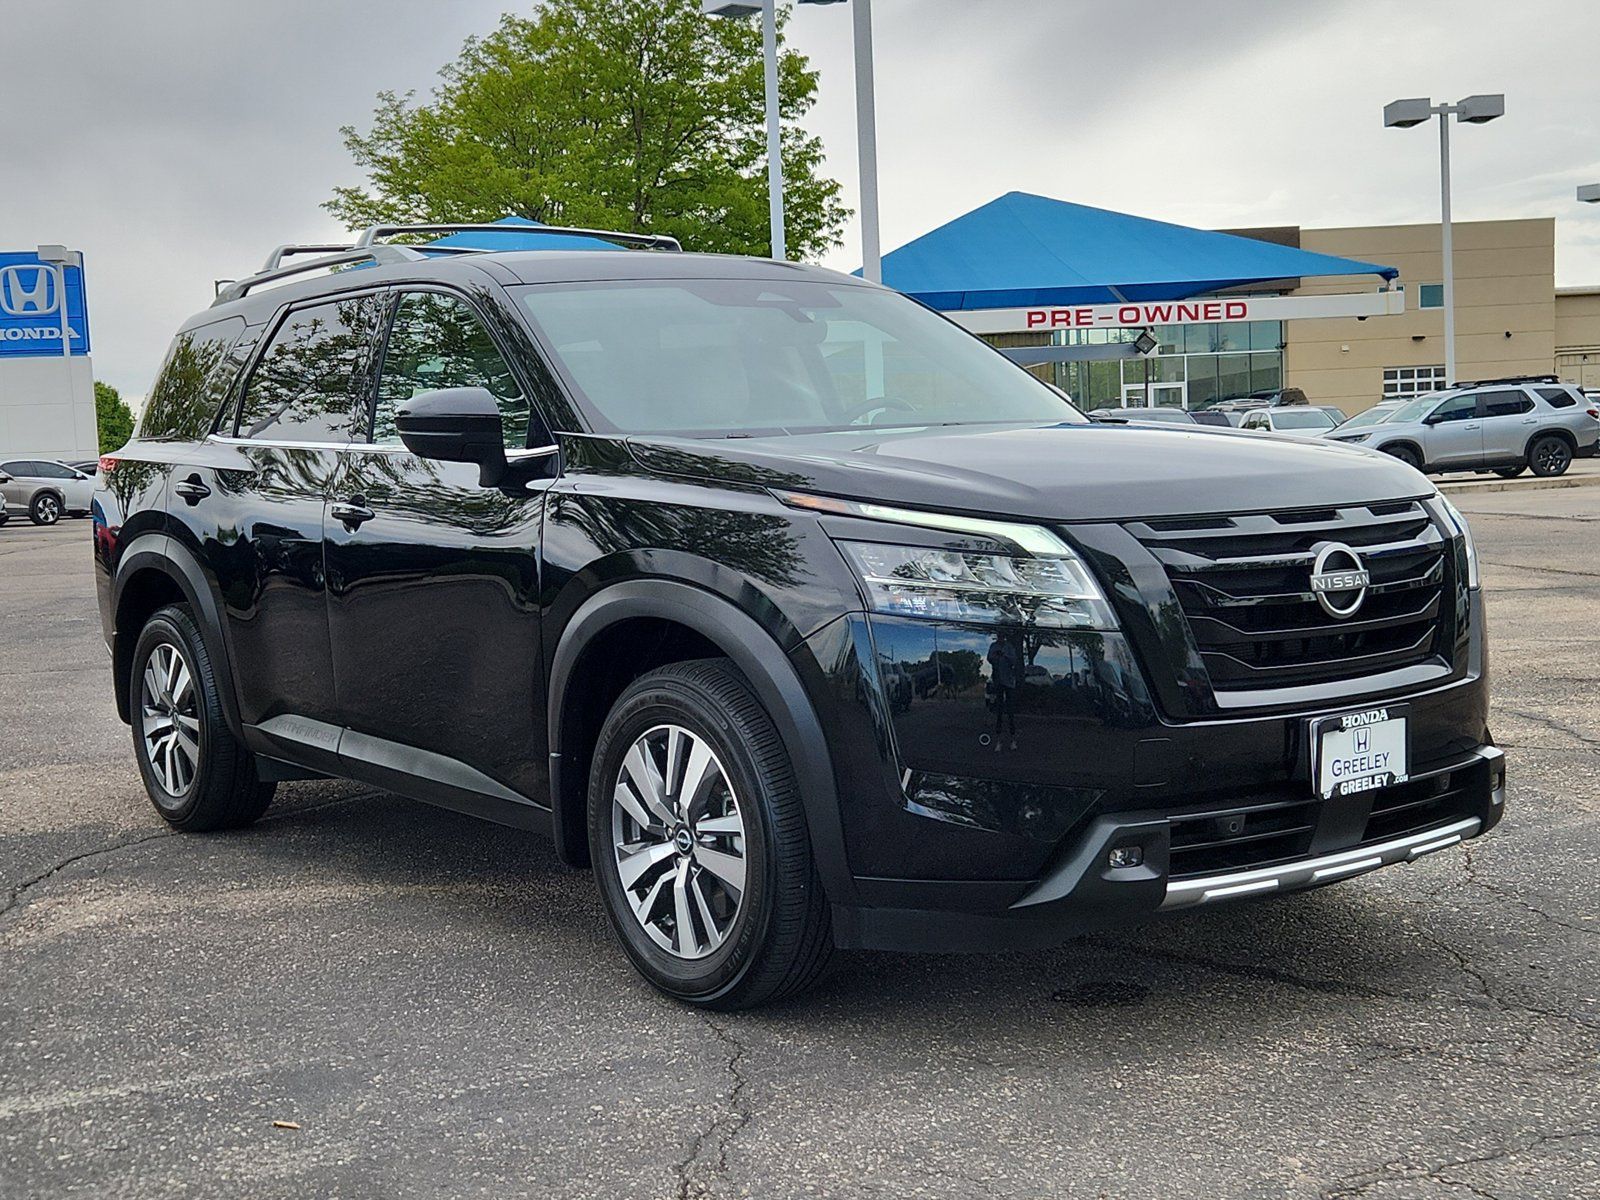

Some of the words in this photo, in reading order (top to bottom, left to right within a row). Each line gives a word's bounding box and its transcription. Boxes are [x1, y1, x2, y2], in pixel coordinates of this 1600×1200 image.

[1026, 302, 1248, 328] PRE-OWNED
[1313, 573, 1369, 590] NISSAN
[1341, 708, 1389, 728] HONDA
[1332, 752, 1390, 777] GREELEY
[1323, 791, 1333, 800] OF
[1340, 773, 1389, 796] GREELEY
